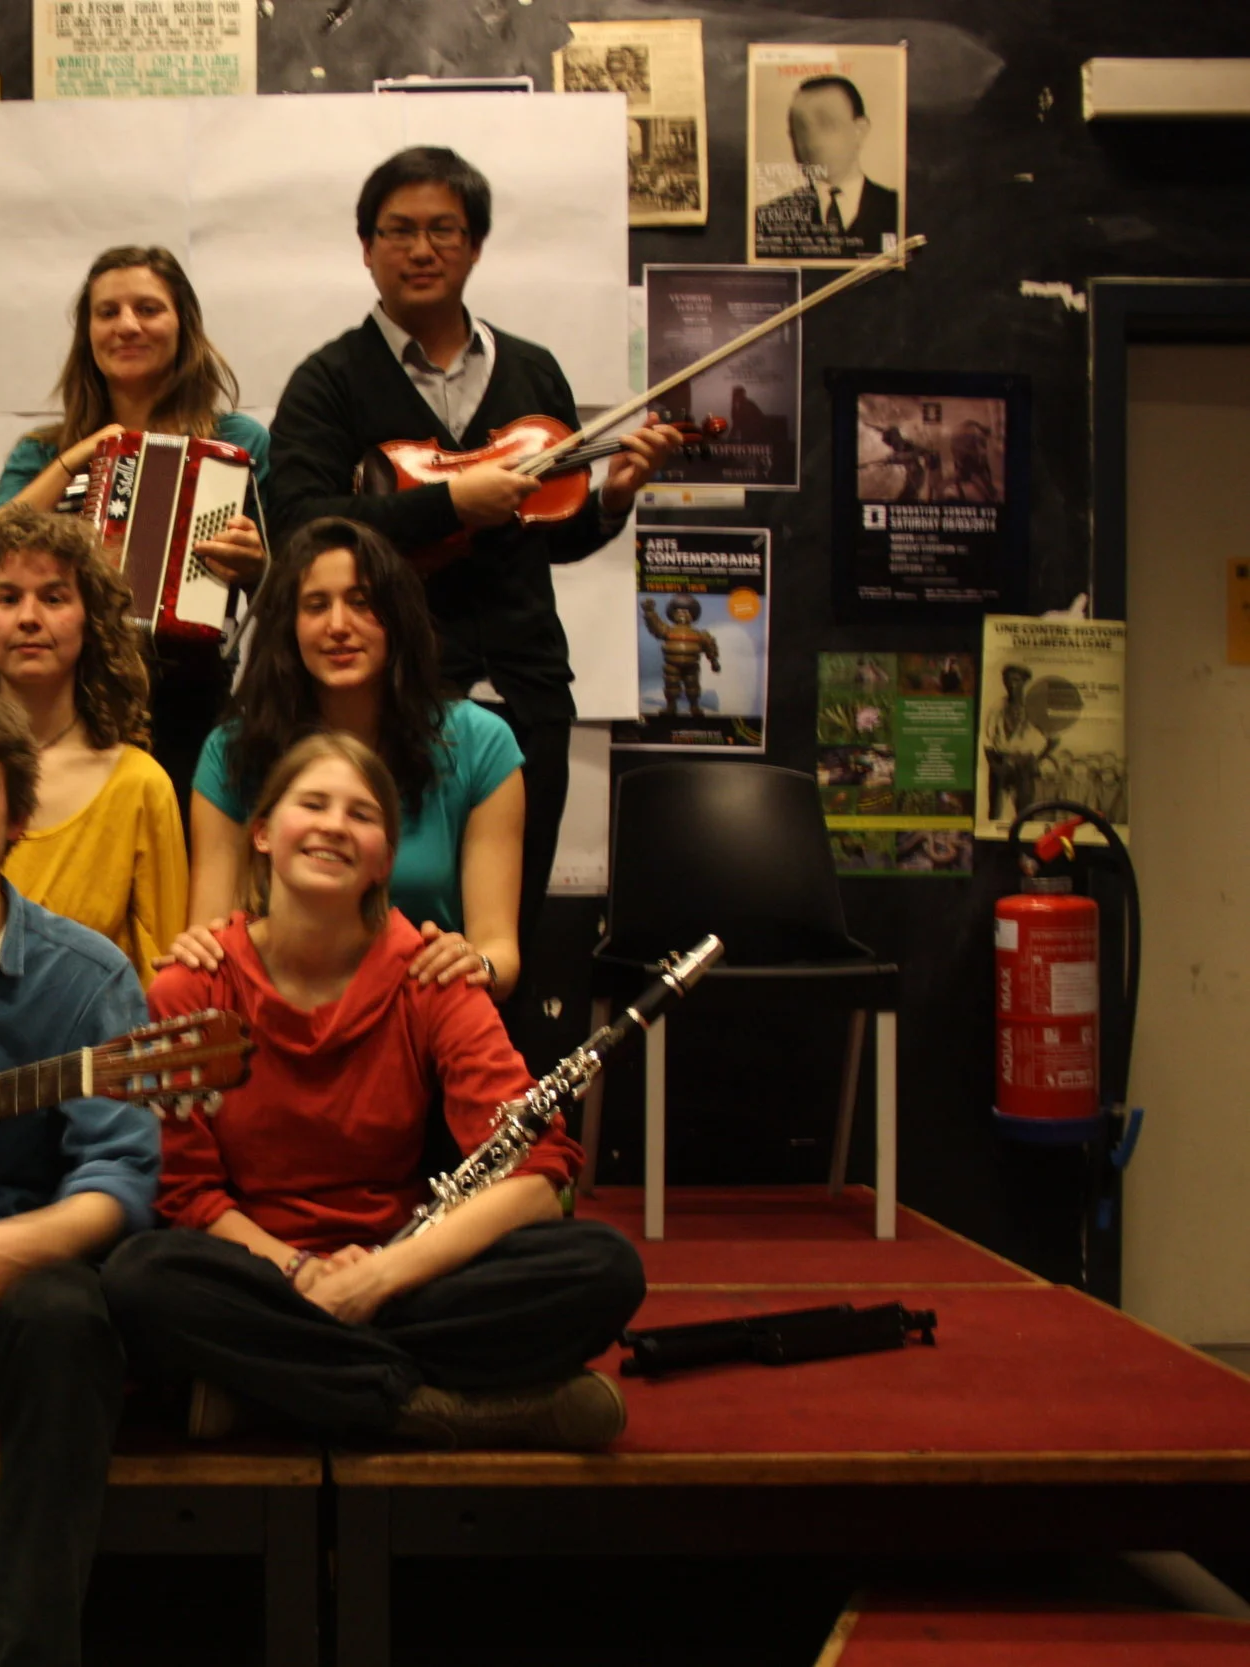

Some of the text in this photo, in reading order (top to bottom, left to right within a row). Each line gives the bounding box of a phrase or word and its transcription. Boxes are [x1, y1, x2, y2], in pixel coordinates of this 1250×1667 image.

[889, 517, 940, 530] SATURDAY
[645, 538, 679, 552] ARTS
[645, 551, 762, 568] CONTEMPORAINS
[994, 623, 1020, 634] UNE
